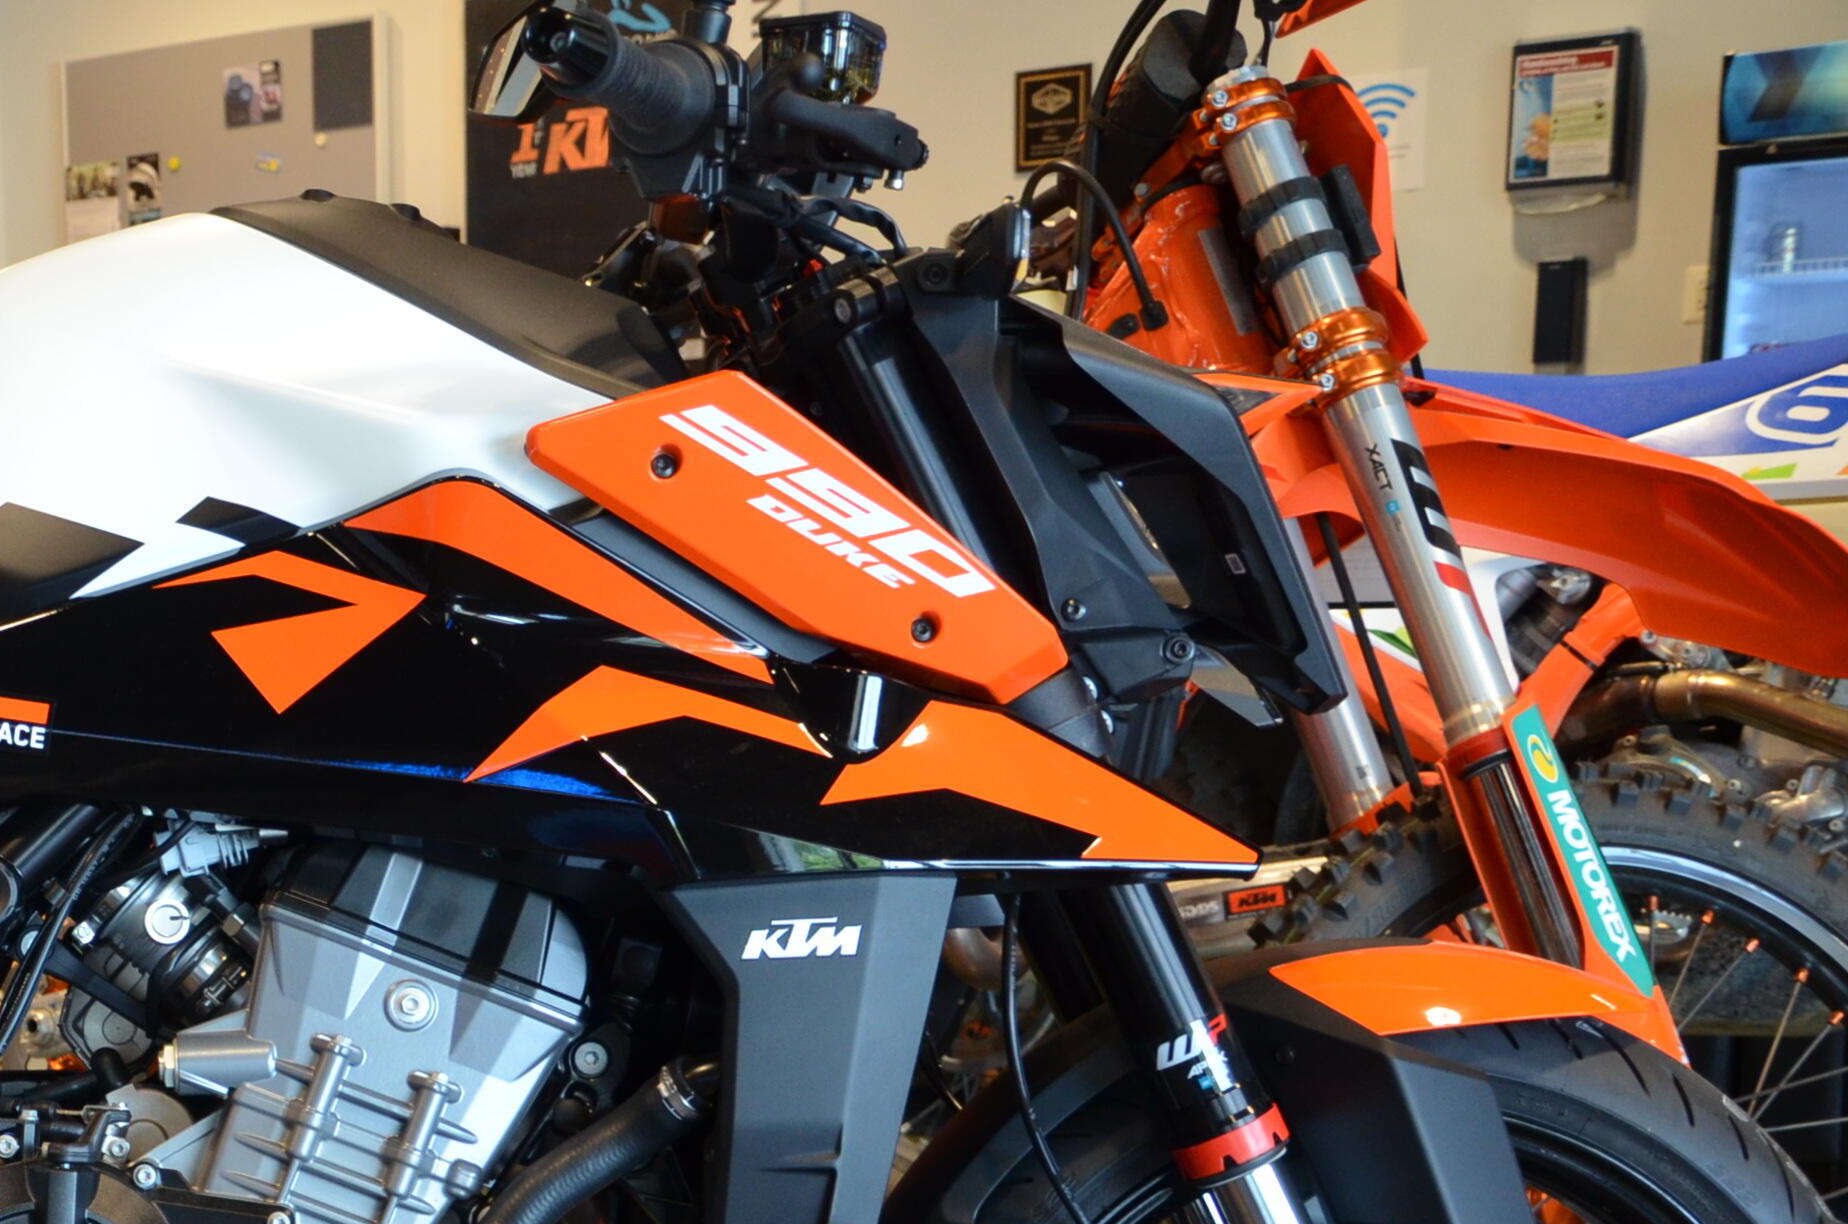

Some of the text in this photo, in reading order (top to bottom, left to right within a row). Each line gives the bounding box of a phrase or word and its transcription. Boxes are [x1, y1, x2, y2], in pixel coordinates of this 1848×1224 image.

[659, 404, 997, 598] 990
[1365, 443, 1393, 491] XACT
[746, 494, 916, 589] DUKE
[1547, 789, 1637, 963] MOTOREX
[740, 917, 862, 960] KTM
